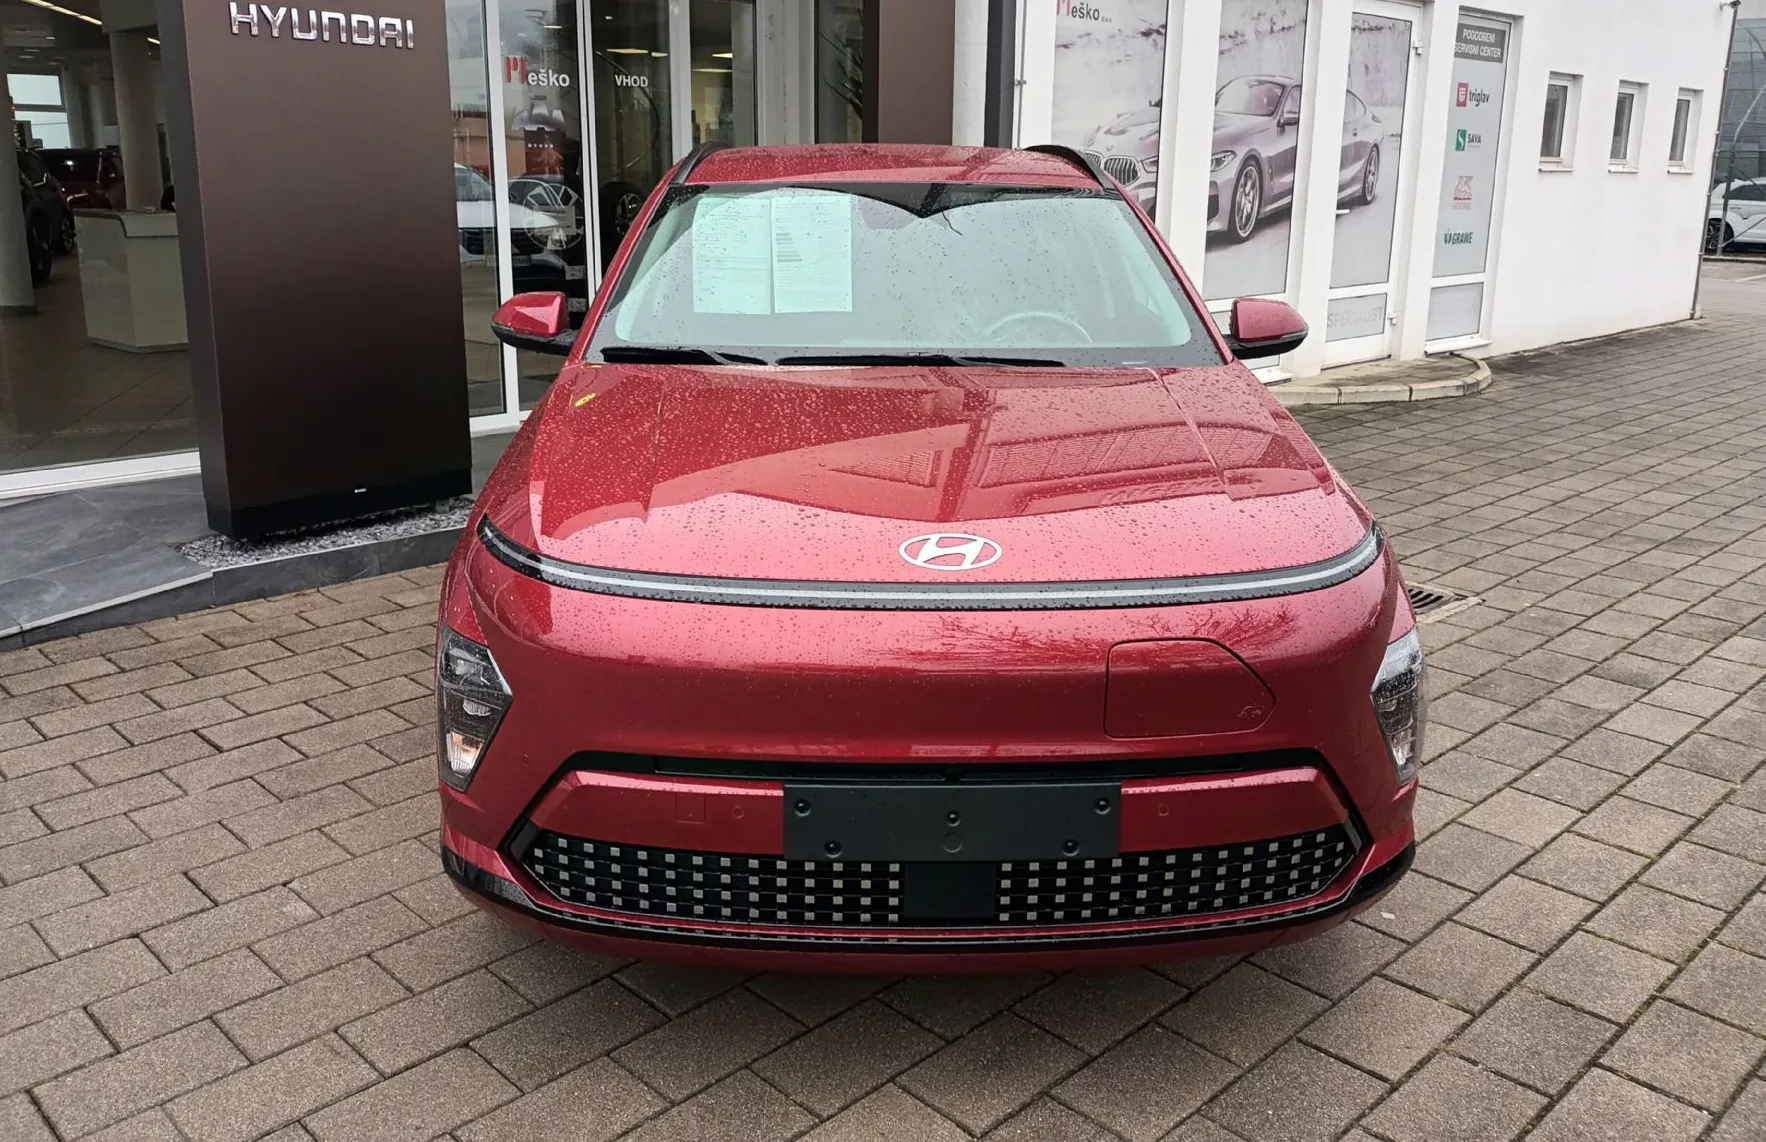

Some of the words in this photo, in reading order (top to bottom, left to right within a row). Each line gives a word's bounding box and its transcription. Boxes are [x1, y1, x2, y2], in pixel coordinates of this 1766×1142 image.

[229, 1, 414, 49] HYUNDAI
[1454, 42, 1479, 56] SERVISNI
[1480, 45, 1501, 58] CENTER
[614, 74, 649, 87] VHOD
[1469, 87, 1490, 107] triglav
[1467, 133, 1481, 144] SAVA
[1452, 232, 1473, 245] GRAWE
[1327, 306, 1383, 328] SPECIALIST
